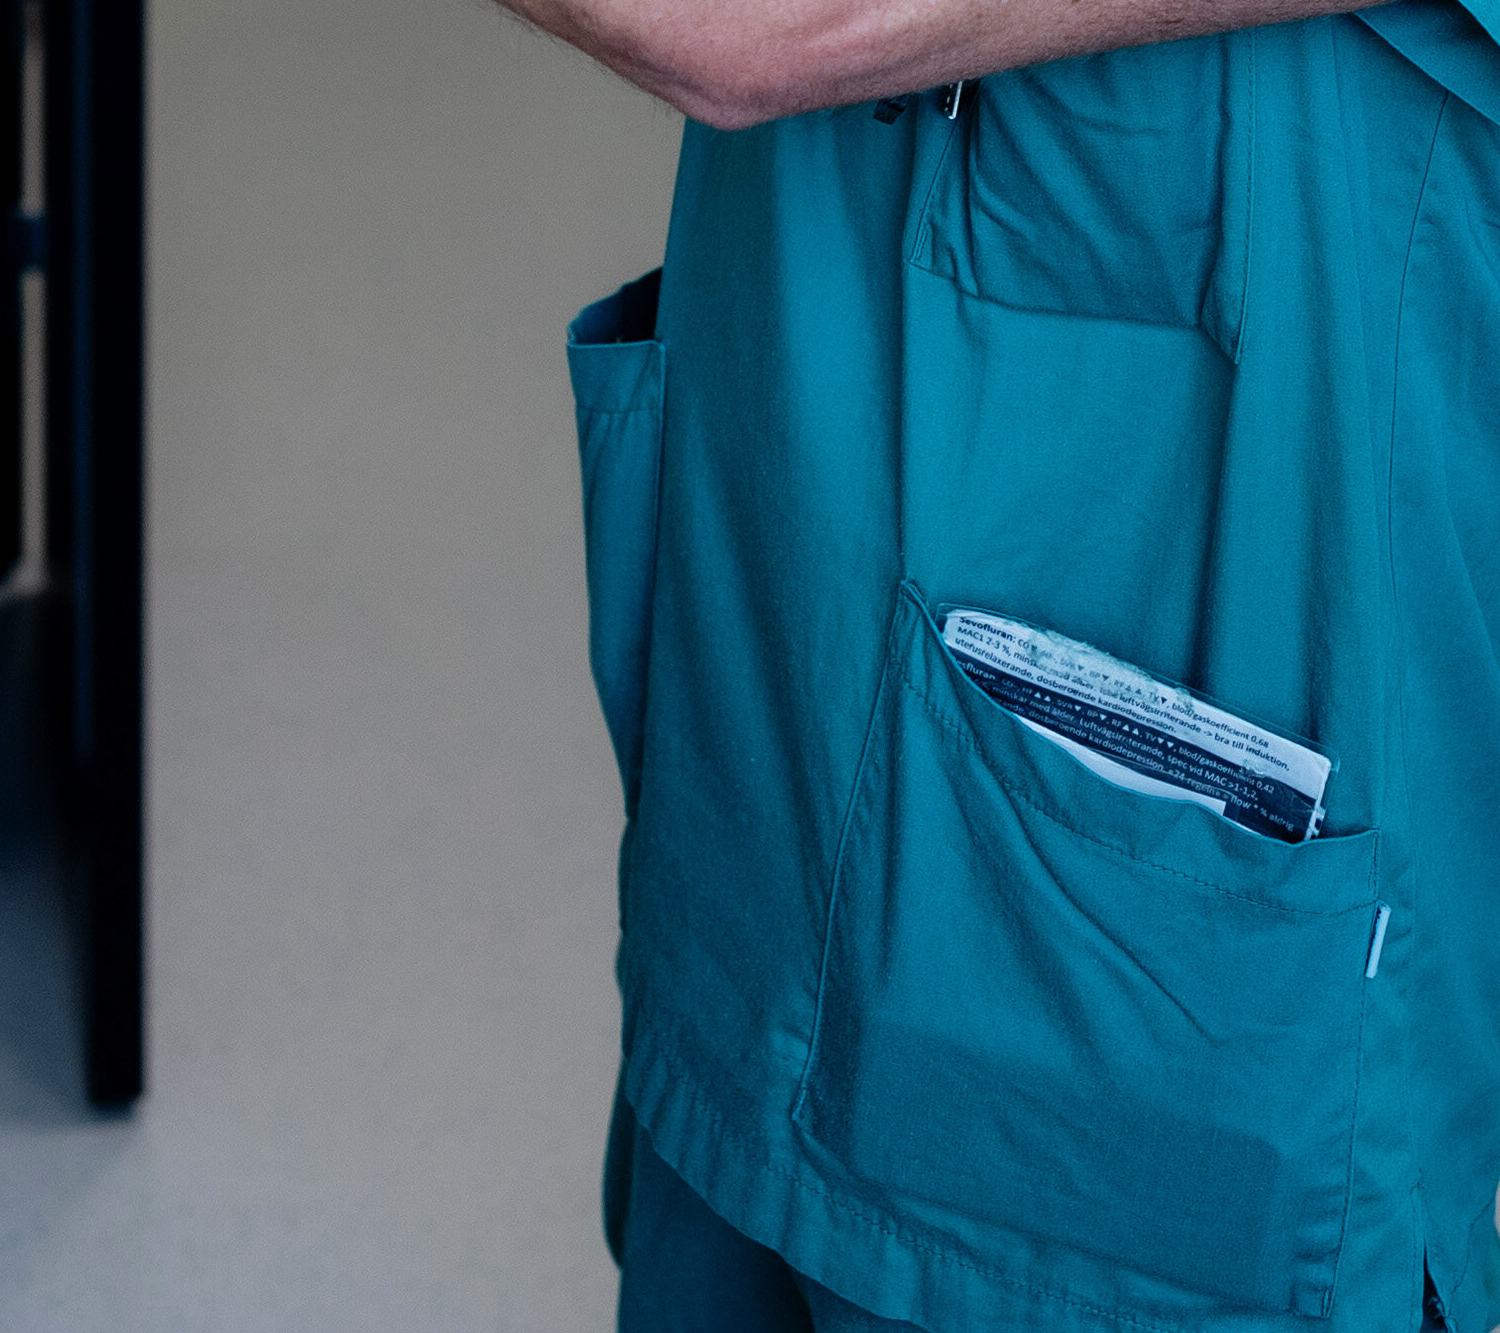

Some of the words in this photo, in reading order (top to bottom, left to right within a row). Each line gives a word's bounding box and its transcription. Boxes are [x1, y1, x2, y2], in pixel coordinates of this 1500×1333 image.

[956, 625, 984, 642] MAC1
[985, 636, 1001, 649] 2-3
[1213, 732, 1230, 745] bra
[1231, 738, 1244, 750] till
[1244, 744, 1292, 771] induktion,
[958, 613, 1016, 644] Sevofluran:
[1170, 702, 1250, 741] blod/gaskoefficient
[1249, 734, 1270, 749] 0,68
[1036, 673, 1096, 703] dosberoende
[1097, 696, 1177, 733] kardiodepression.
[1029, 711, 1088, 738] dosberoende
[1029, 699, 1050, 712] med
[1166, 754, 1189, 769] spec
[1188, 763, 1204, 775] vid
[1203, 770, 1227, 786] MAC
[1255, 780, 1275, 795] 0,42
